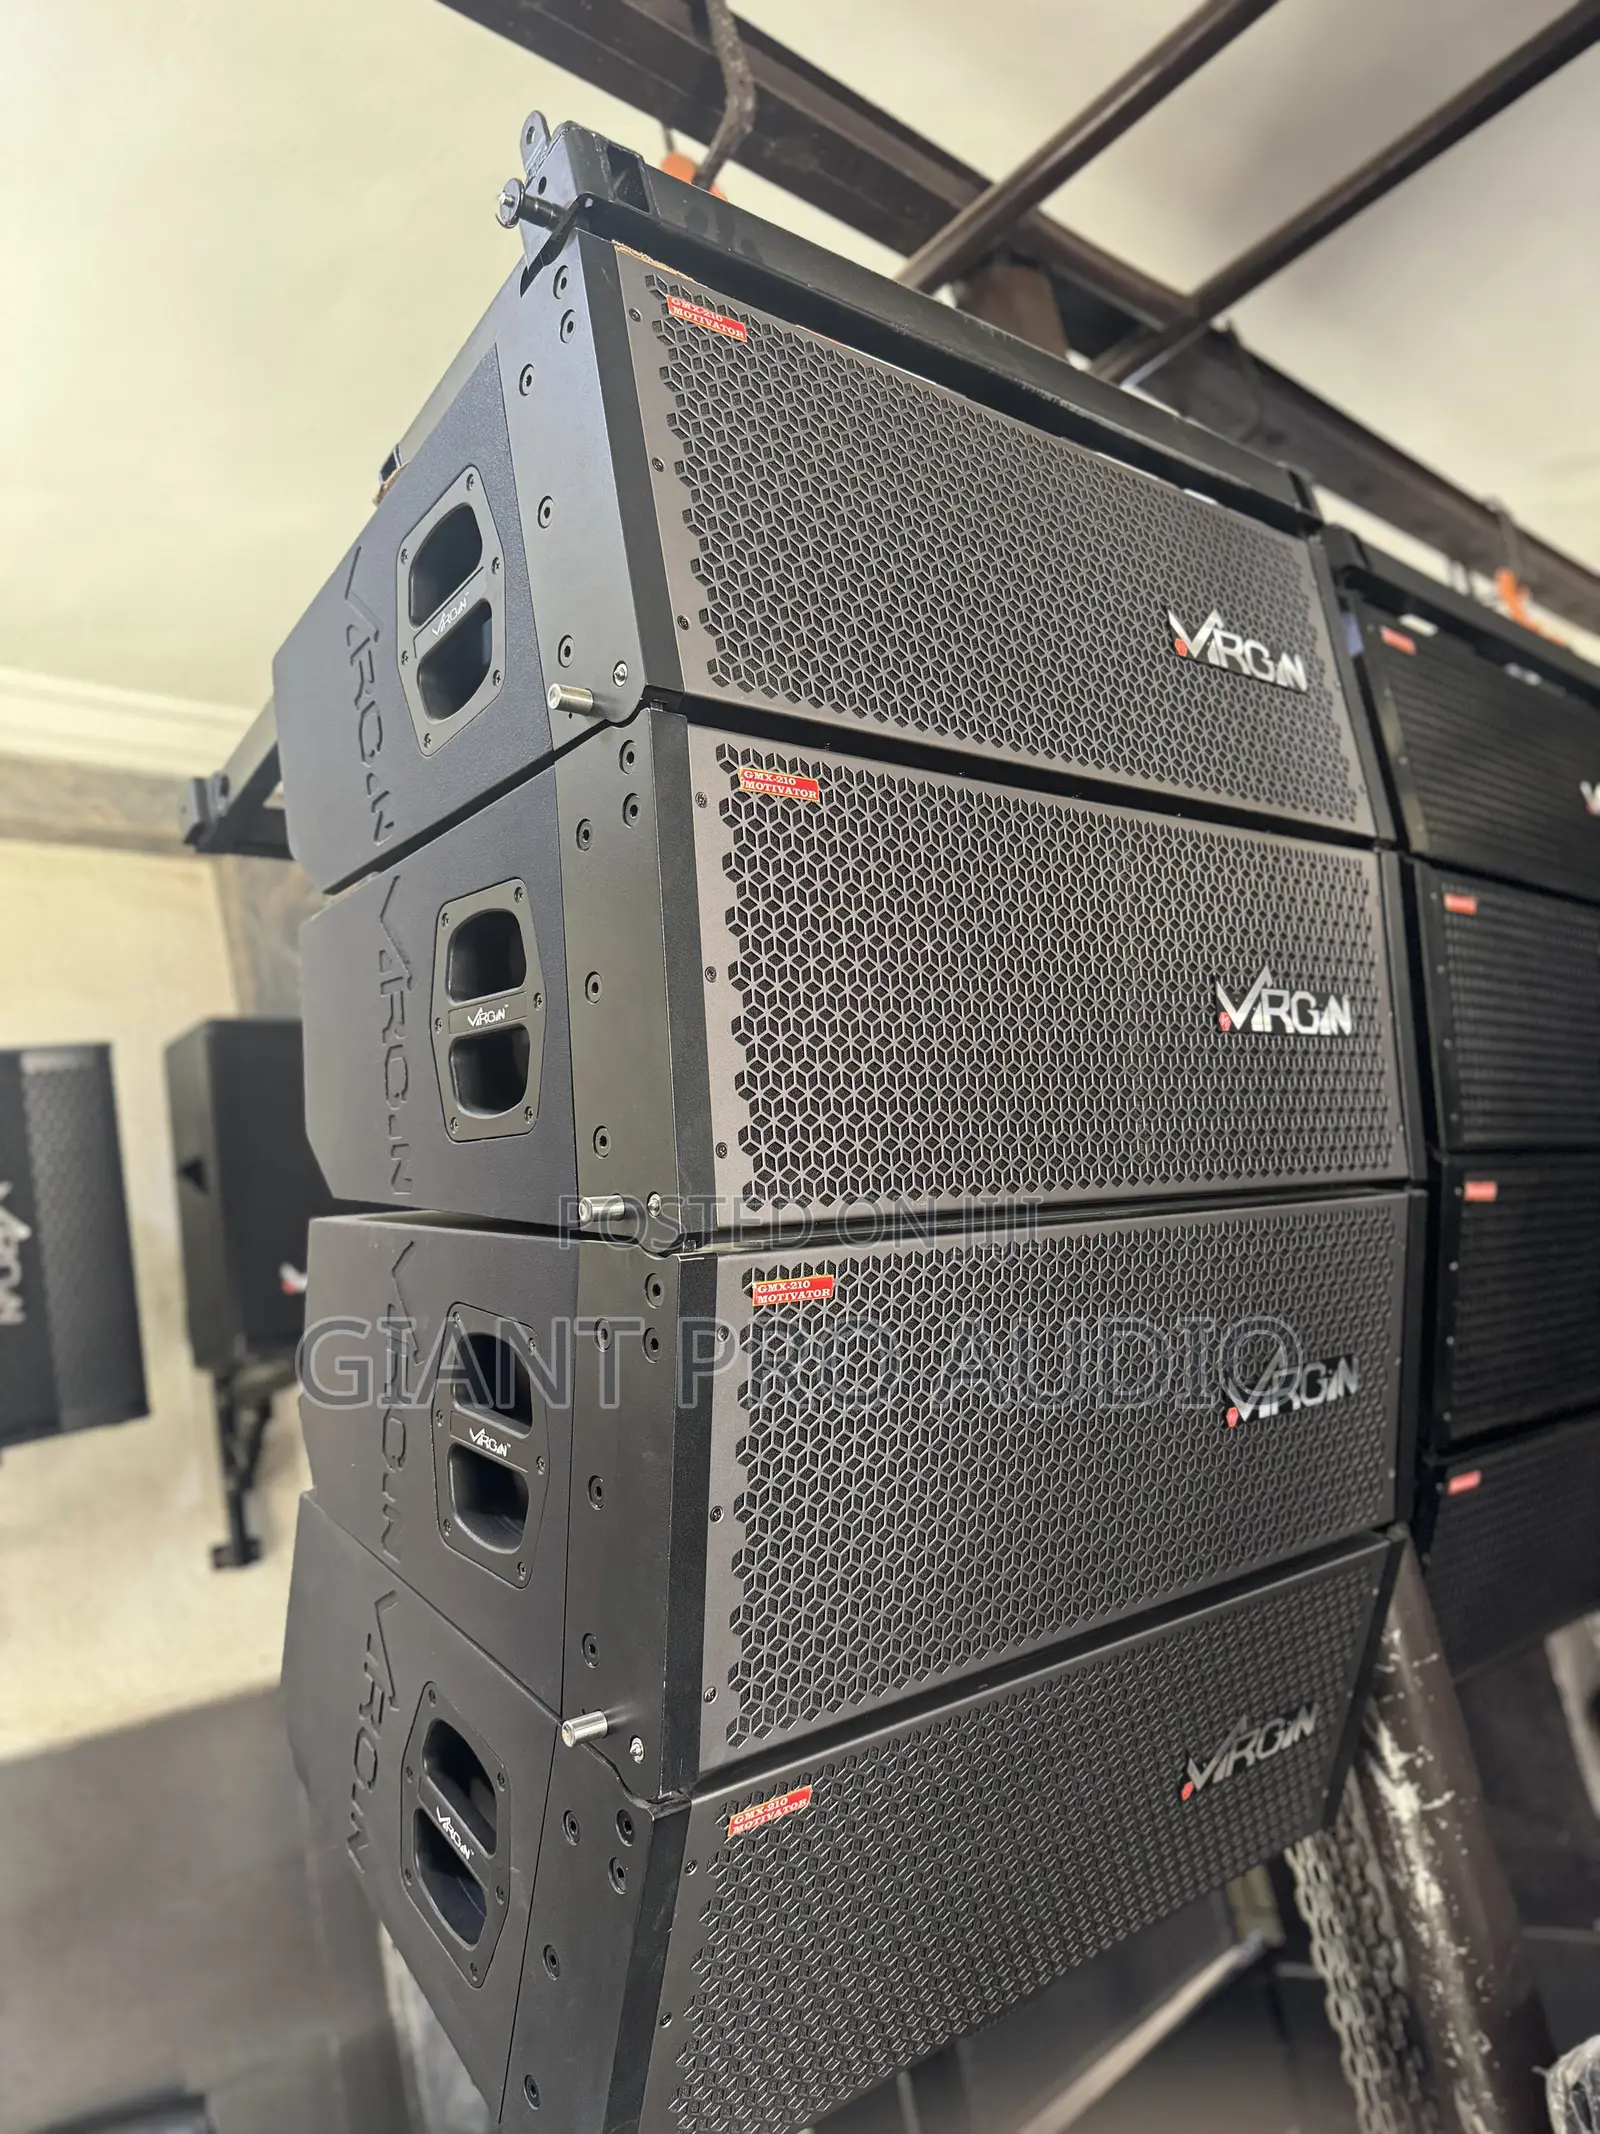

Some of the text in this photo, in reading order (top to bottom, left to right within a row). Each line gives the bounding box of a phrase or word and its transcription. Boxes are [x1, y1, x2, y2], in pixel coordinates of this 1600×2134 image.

[671, 296, 724, 323] GMX-210
[672, 305, 745, 339] MOTIVATOR
[1167, 608, 1308, 692] VIRGIN
[743, 770, 797, 786] GMX-210
[745, 780, 817, 799] MOTIVATOR
[1215, 964, 1352, 1036] VIRGIN
[467, 1006, 506, 1027] VIRGIN
[756, 1288, 831, 1304] MOTIVATOR
[757, 1280, 811, 1294] GMX-210
[469, 1427, 508, 1457] VIRGIN
[1186, 1702, 1320, 1792] VIRGIN
[732, 1798, 807, 1835] MOTIVATOR
[733, 1797, 789, 1825] GMX-210
